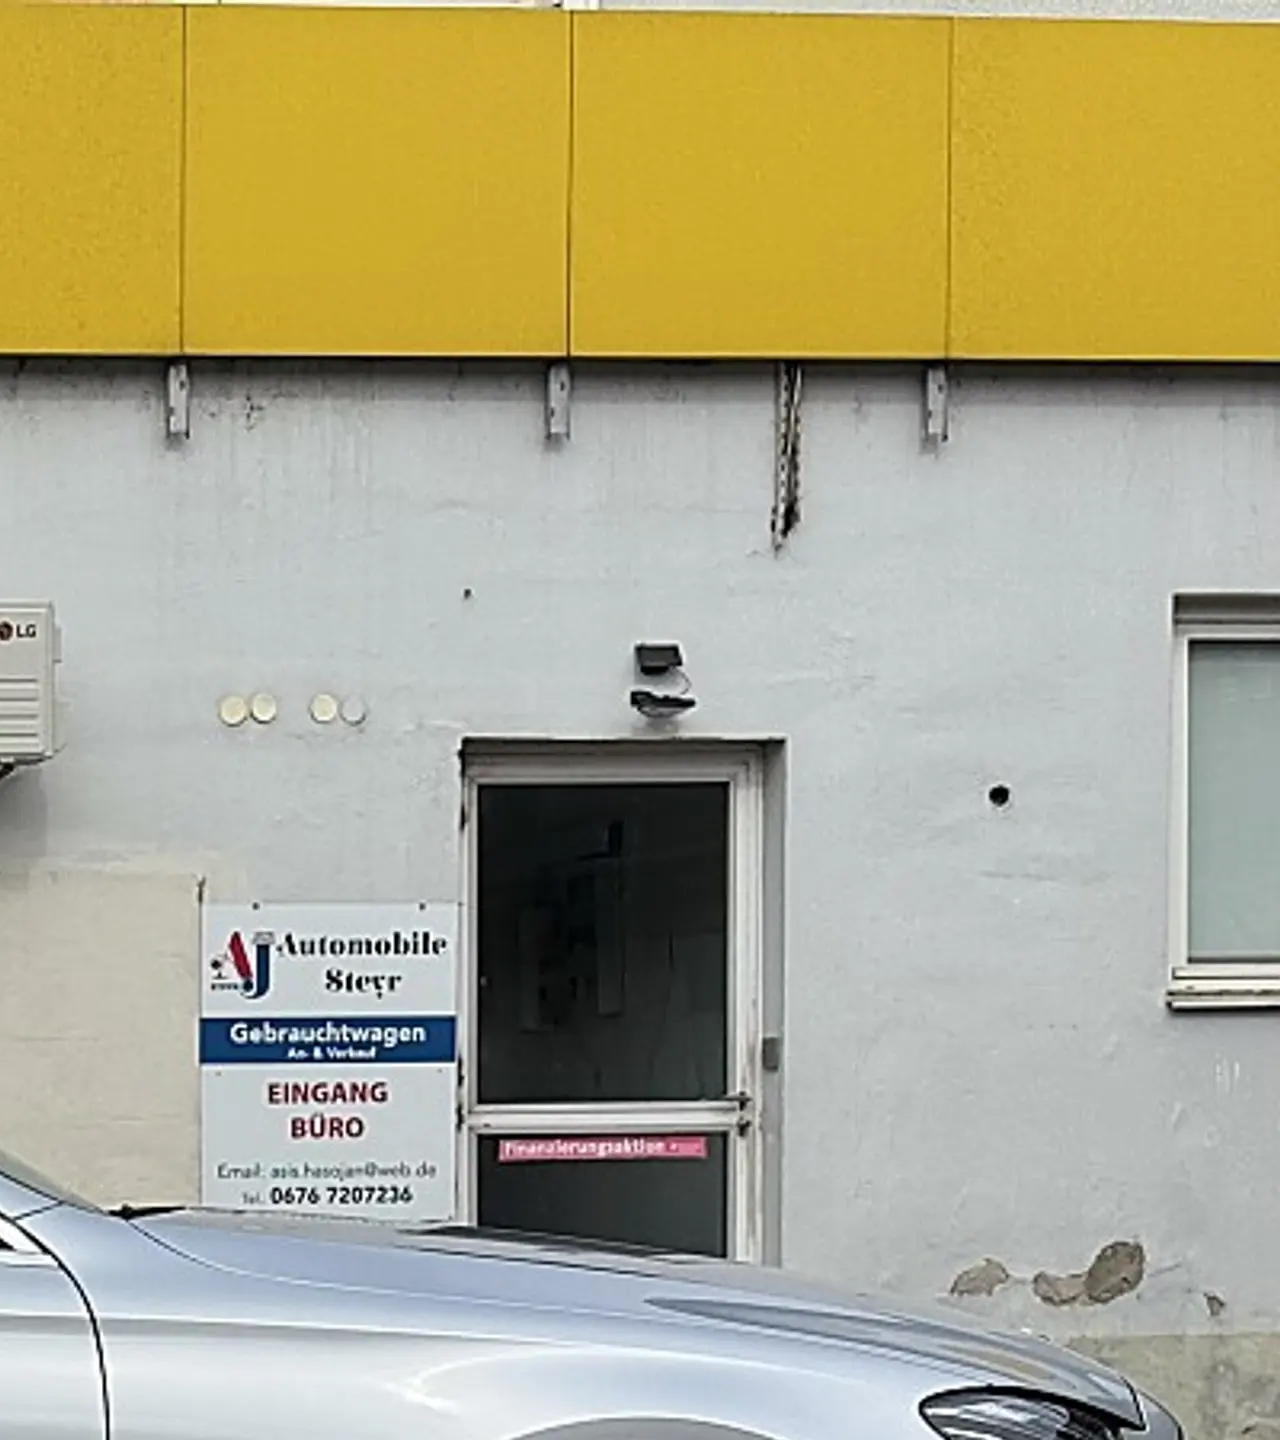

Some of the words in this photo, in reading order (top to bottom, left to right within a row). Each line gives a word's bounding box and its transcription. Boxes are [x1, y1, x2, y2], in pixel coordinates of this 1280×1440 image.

[16, 624, 37, 638] LG
[276, 931, 447, 957] Automobile
[325, 968, 402, 999] Steyr
[230, 1021, 426, 1048] Gebrauchtwagen
[326, 1046, 377, 1059] Verkauf
[267, 1082, 389, 1104] EINGANG
[290, 1113, 364, 1139] BÜRO
[270, 1187, 321, 1204] 0676
[326, 1187, 413, 1204] 7207236
